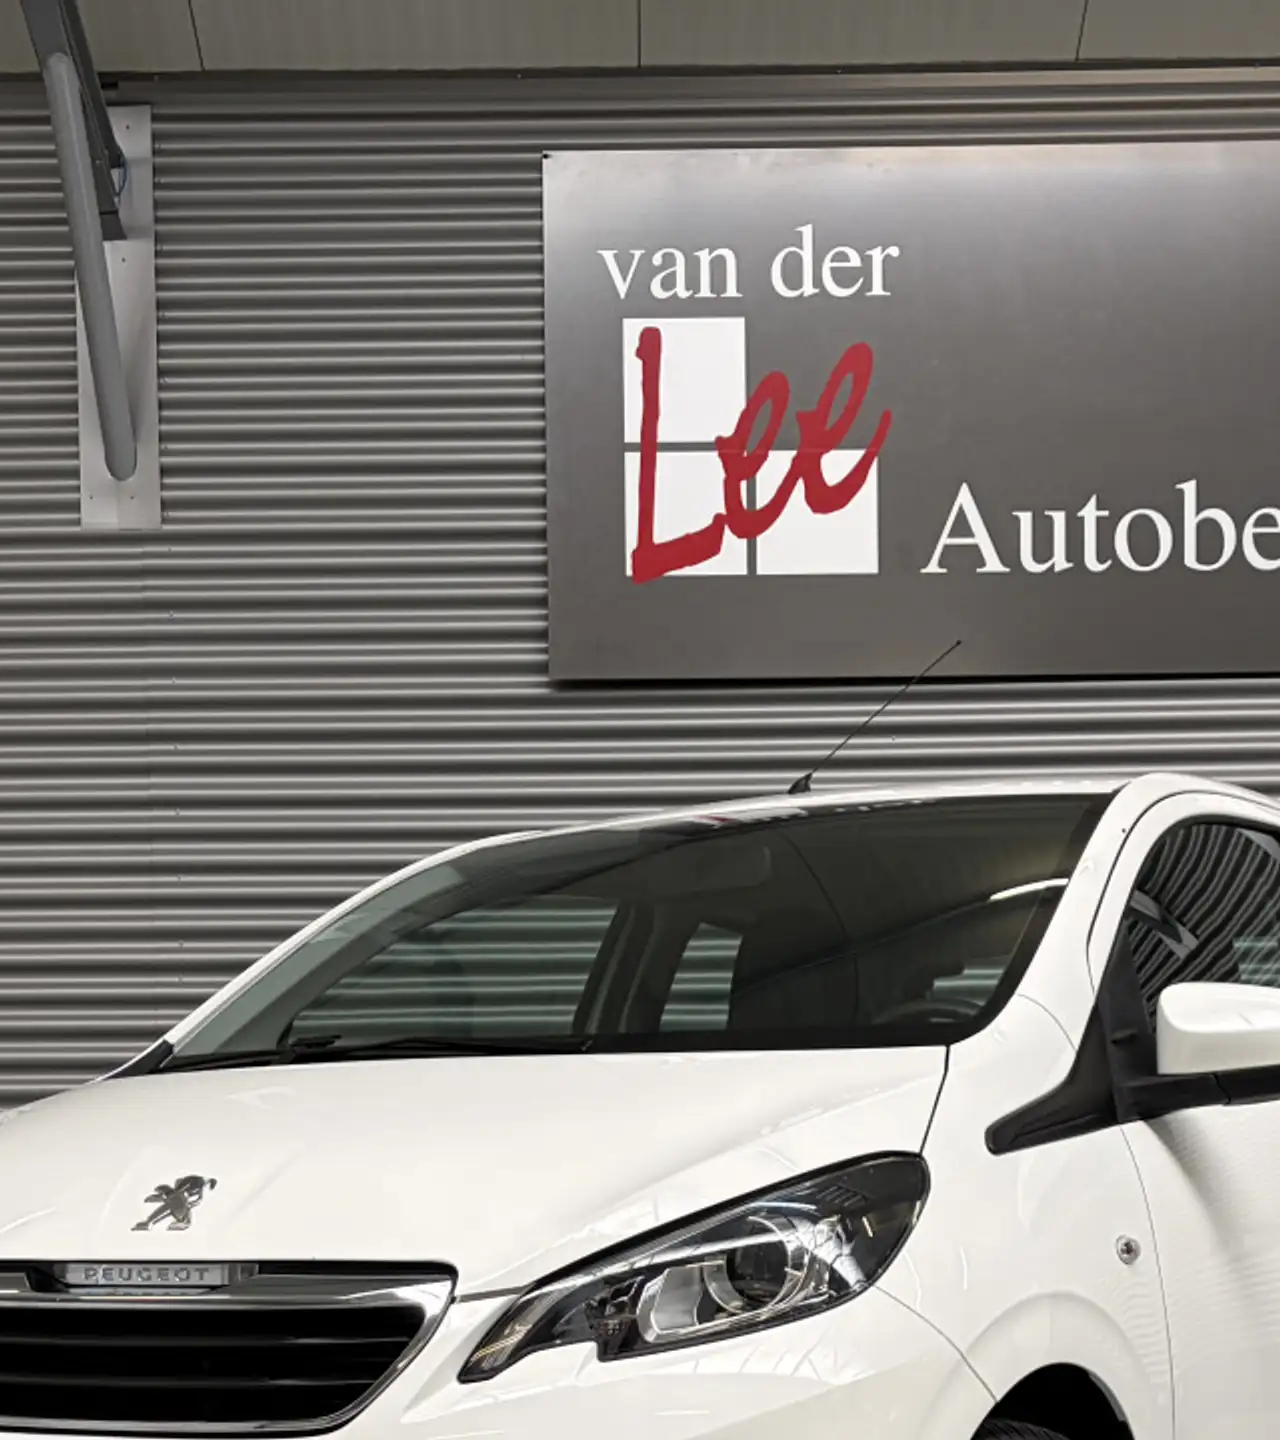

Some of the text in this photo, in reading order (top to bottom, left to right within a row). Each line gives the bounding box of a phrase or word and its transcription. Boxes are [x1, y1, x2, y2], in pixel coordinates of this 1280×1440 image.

[596, 224, 902, 301] van der
[630, 326, 894, 585] Lee
[83, 1266, 210, 1282] PEUGEOT
